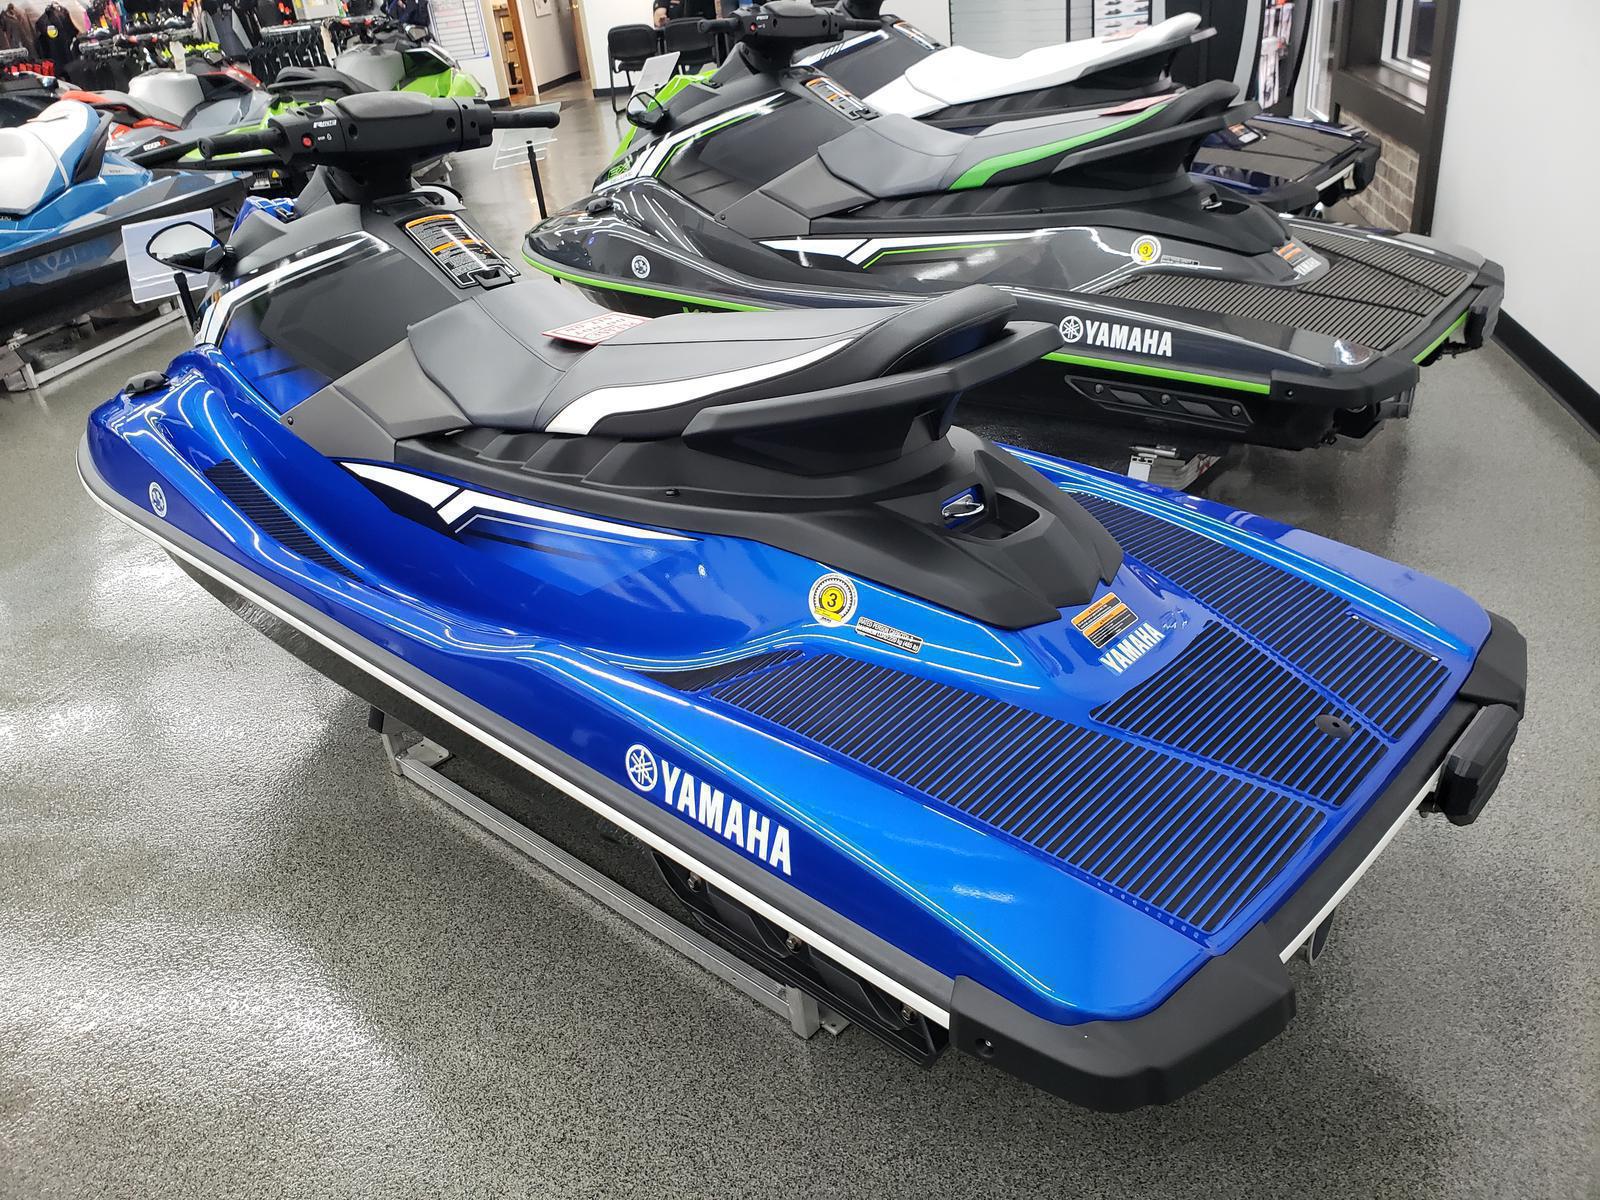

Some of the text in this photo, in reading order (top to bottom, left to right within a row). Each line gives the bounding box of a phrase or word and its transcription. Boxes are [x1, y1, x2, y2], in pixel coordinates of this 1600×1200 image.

[1142, 246, 1149, 255] 3
[1085, 319, 1173, 357] YAMAHA
[826, 592, 838, 608] 3
[1099, 622, 1166, 674] YAMAHA
[661, 759, 792, 876] YAMAHA
